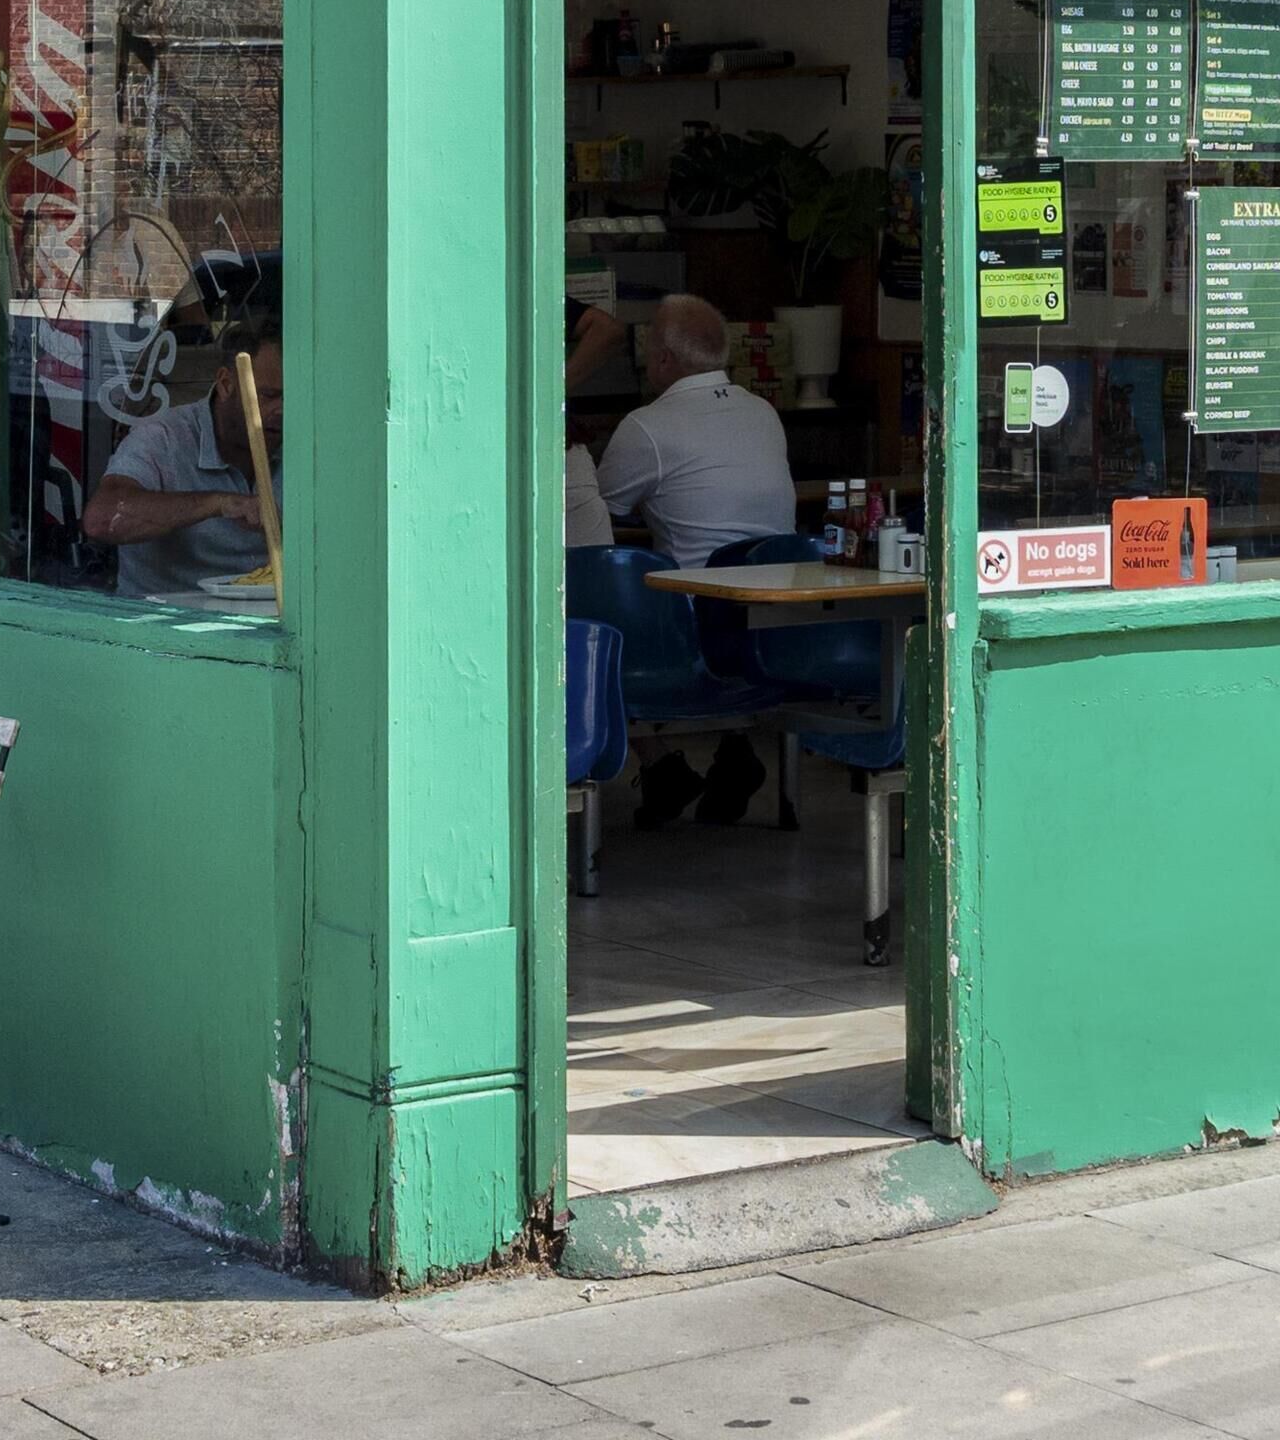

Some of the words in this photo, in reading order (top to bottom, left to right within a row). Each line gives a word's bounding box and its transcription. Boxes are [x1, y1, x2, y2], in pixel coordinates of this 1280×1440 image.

[983, 188, 1003, 196] FOOD
[1004, 187, 1032, 196] HYGIENE
[1033, 186, 1056, 195] RATING
[1046, 206, 1056, 221] 5
[1206, 262, 1251, 270] CUMBERLAND
[985, 274, 1005, 282] FOOD
[1006, 273, 1035, 282] HYGIENE
[1036, 272, 1059, 281] RATING
[1047, 292, 1057, 307] 5
[1207, 292, 1243, 300] TOMATOES
[1026, 542, 1049, 560] No
[1055, 540, 1097, 560] dogs
[1122, 557, 1145, 570] Sold
[1146, 557, 1170, 570] here
[1028, 566, 1053, 578] except
[1054, 565, 1075, 577] guide
[1077, 565, 1096, 576] dogs
